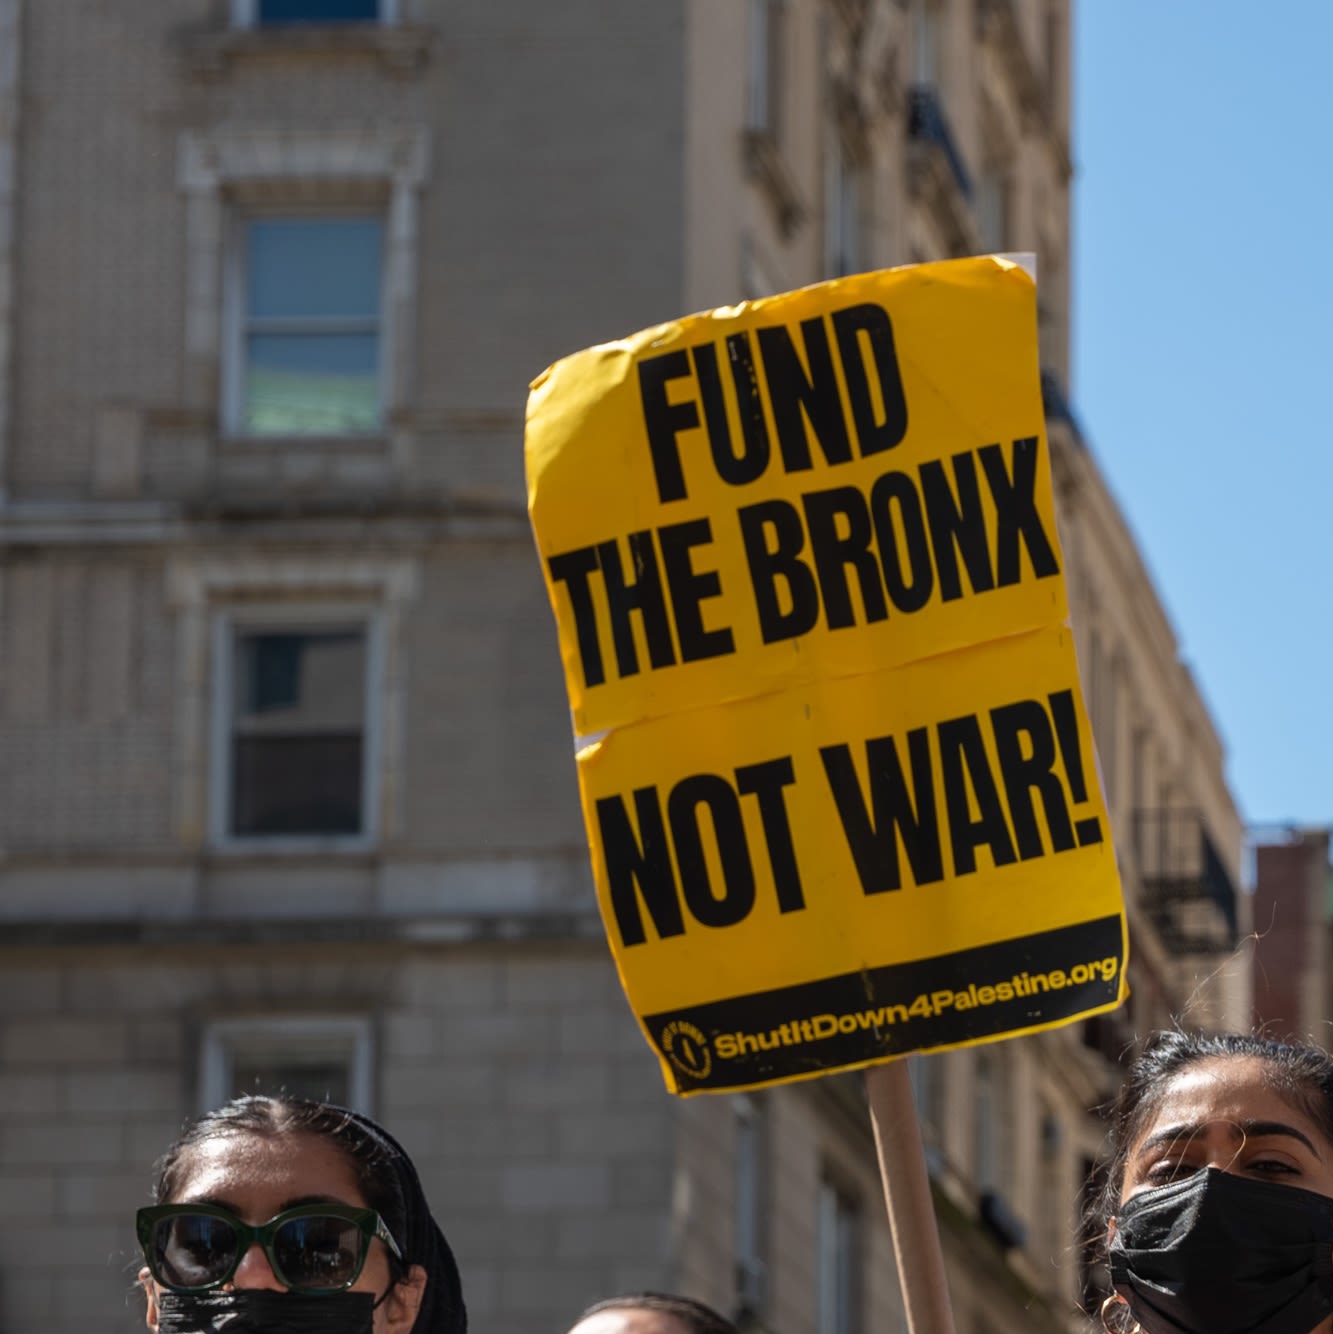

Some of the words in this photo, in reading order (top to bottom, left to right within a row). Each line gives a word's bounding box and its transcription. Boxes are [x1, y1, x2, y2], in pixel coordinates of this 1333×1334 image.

[639, 302, 908, 504] FUND
[548, 516, 736, 689] THE
[737, 435, 1060, 646] BRONX
[595, 755, 806, 947] NOT
[819, 688, 1103, 898] WAR!
[713, 955, 1118, 1060] ShutItDown4Palestine.org
